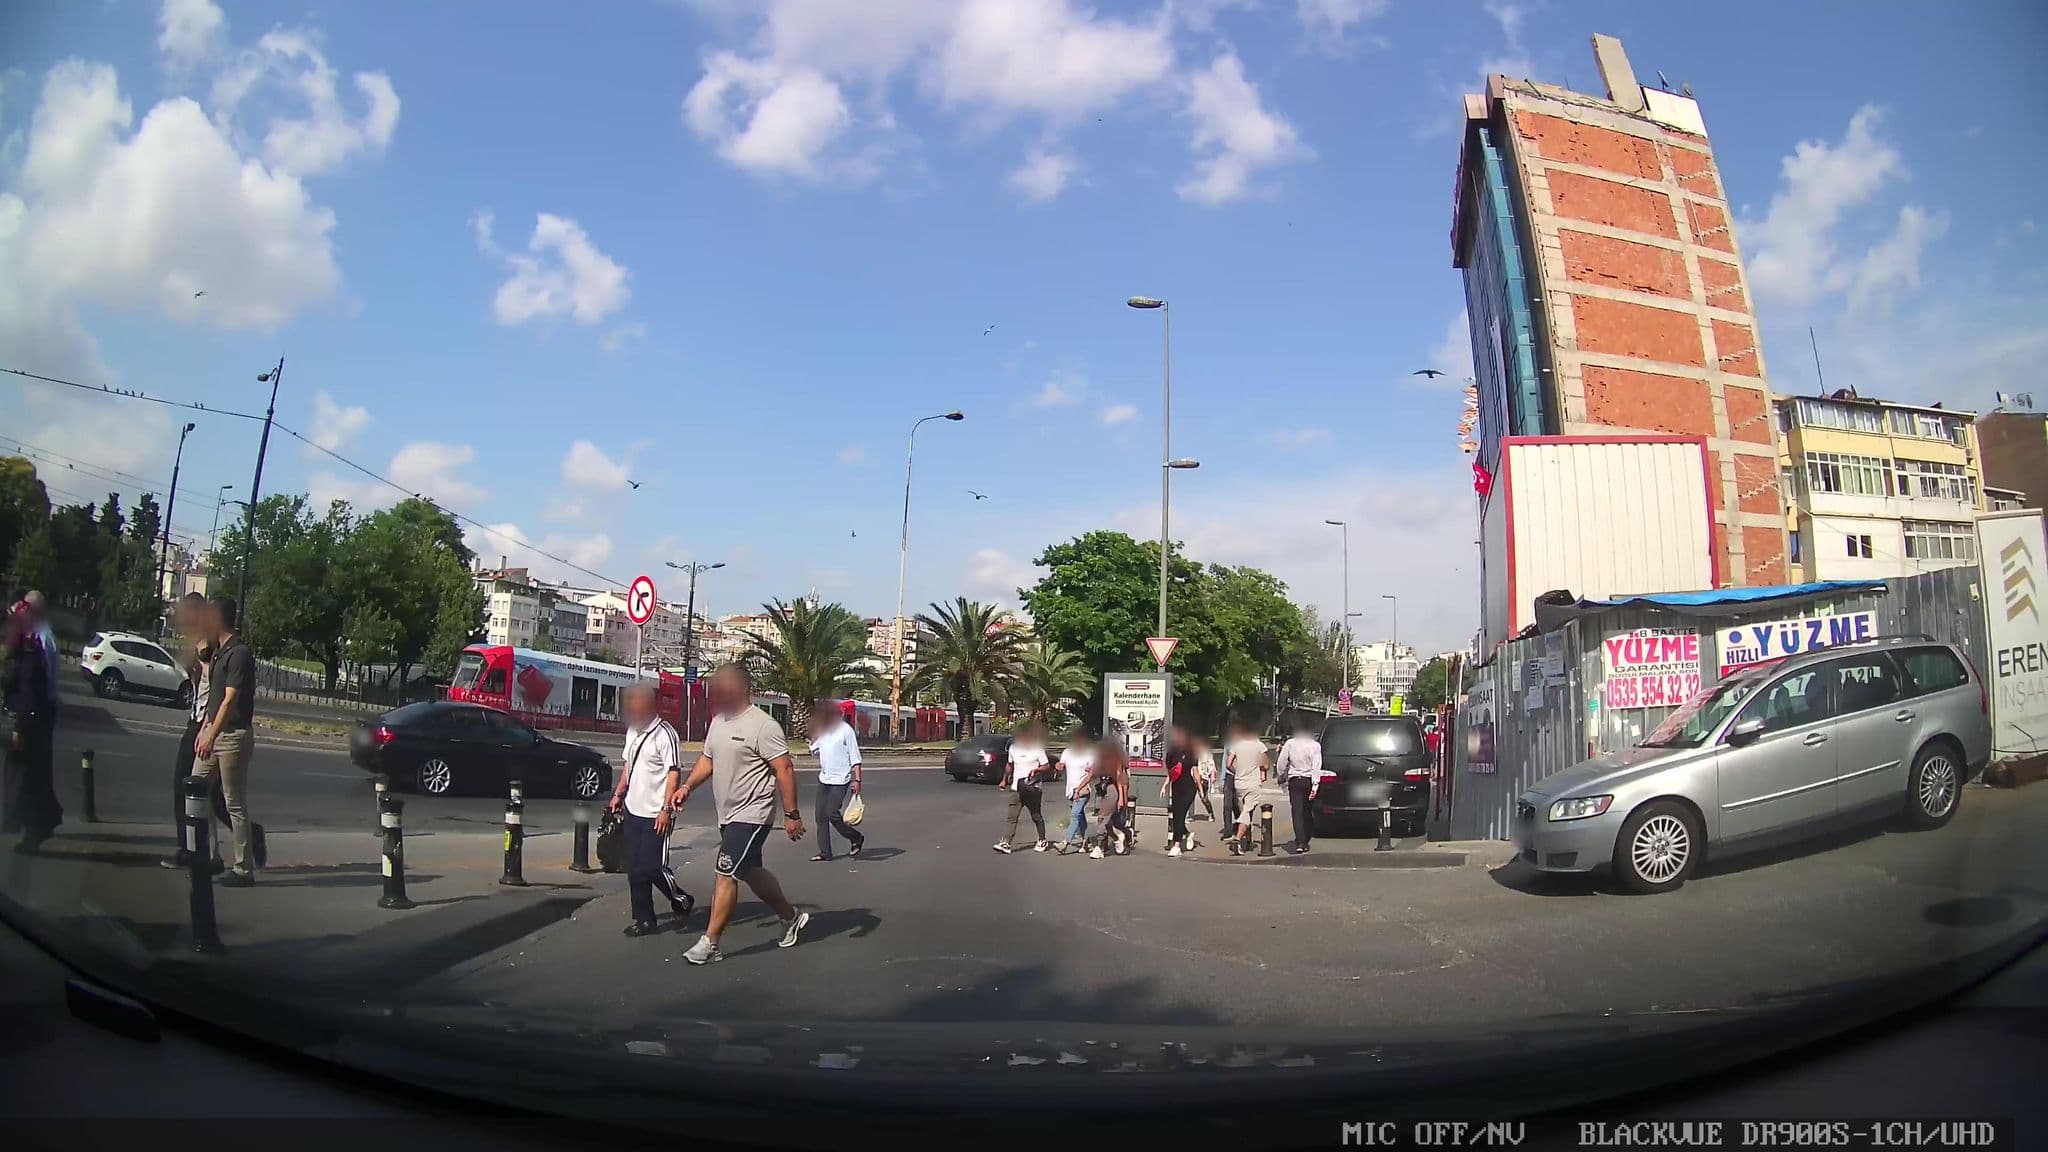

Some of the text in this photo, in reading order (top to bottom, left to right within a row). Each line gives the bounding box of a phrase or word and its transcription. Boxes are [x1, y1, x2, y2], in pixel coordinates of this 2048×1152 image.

[1651, 627, 1697, 637] SAATTE
[1752, 614, 1870, 656] YÜZME
[1604, 632, 1699, 669] YÜZME
[1726, 647, 1759, 665] HIZLI
[1606, 677, 1638, 708] 0535
[1641, 675, 1665, 705] 554
[1667, 674, 1683, 704] 32
